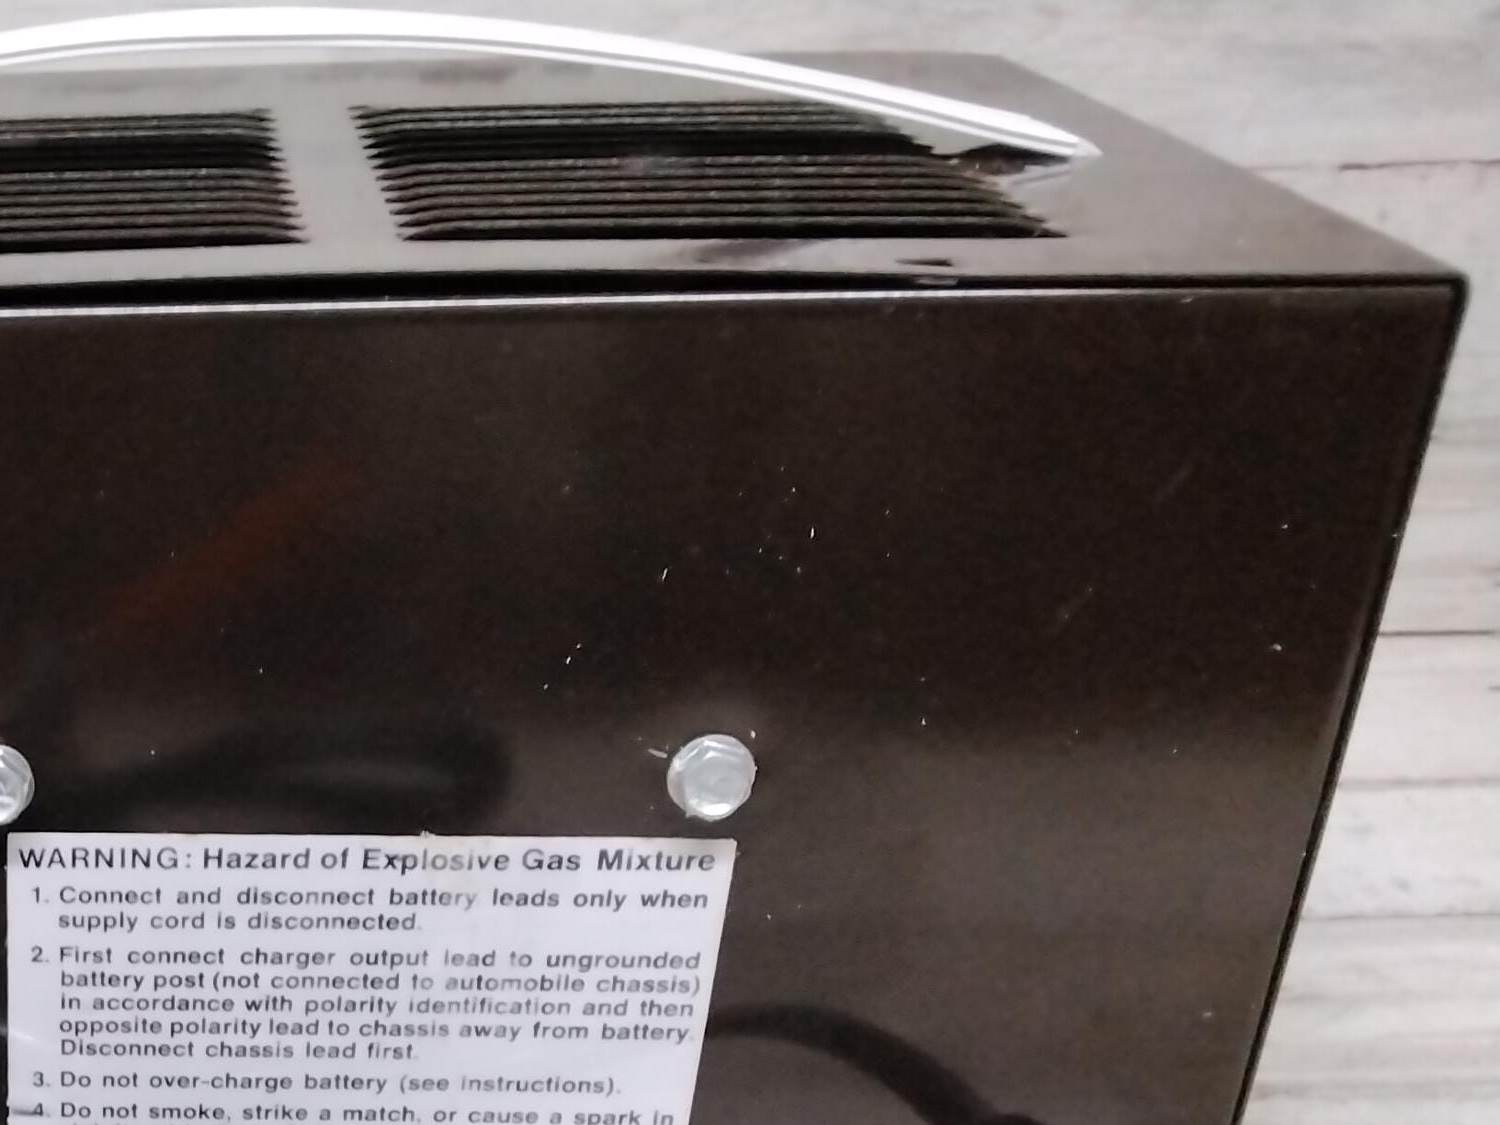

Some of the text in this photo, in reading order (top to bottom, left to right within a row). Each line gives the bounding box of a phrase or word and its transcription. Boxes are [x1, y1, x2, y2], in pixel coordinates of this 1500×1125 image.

[18, 848, 715, 875] WARNING: Hazard of Explosive Gas Mixture
[31, 886, 708, 912] 1. Connect and disconnect battery leads only when
[58, 912, 421, 932] supply cord is disconnected.
[31, 946, 700, 972] 2. First connect charger output lead to ungrounded
[60, 972, 700, 996] battery post (not connected to automobile chassis)
[61, 995, 694, 1017] in accordance with polarity identification and then
[60, 1018, 695, 1044] opposite polarity lead to chassis away from battery.
[60, 1039, 418, 1059] Disconnect chassis lead first.
[32, 1071, 620, 1097] 3. Do not over-charge battery (see instructions).
[60, 1103, 91, 1118] Do
[102, 1104, 137, 1118] not
[149, 1104, 231, 1122] smoke,
[243, 1104, 307, 1121] strike
[319, 1109, 331, 1121] a
[434, 1110, 455, 1123] or
[468, 1110, 538, 1124] cause
[550, 1112, 562, 1125] a
